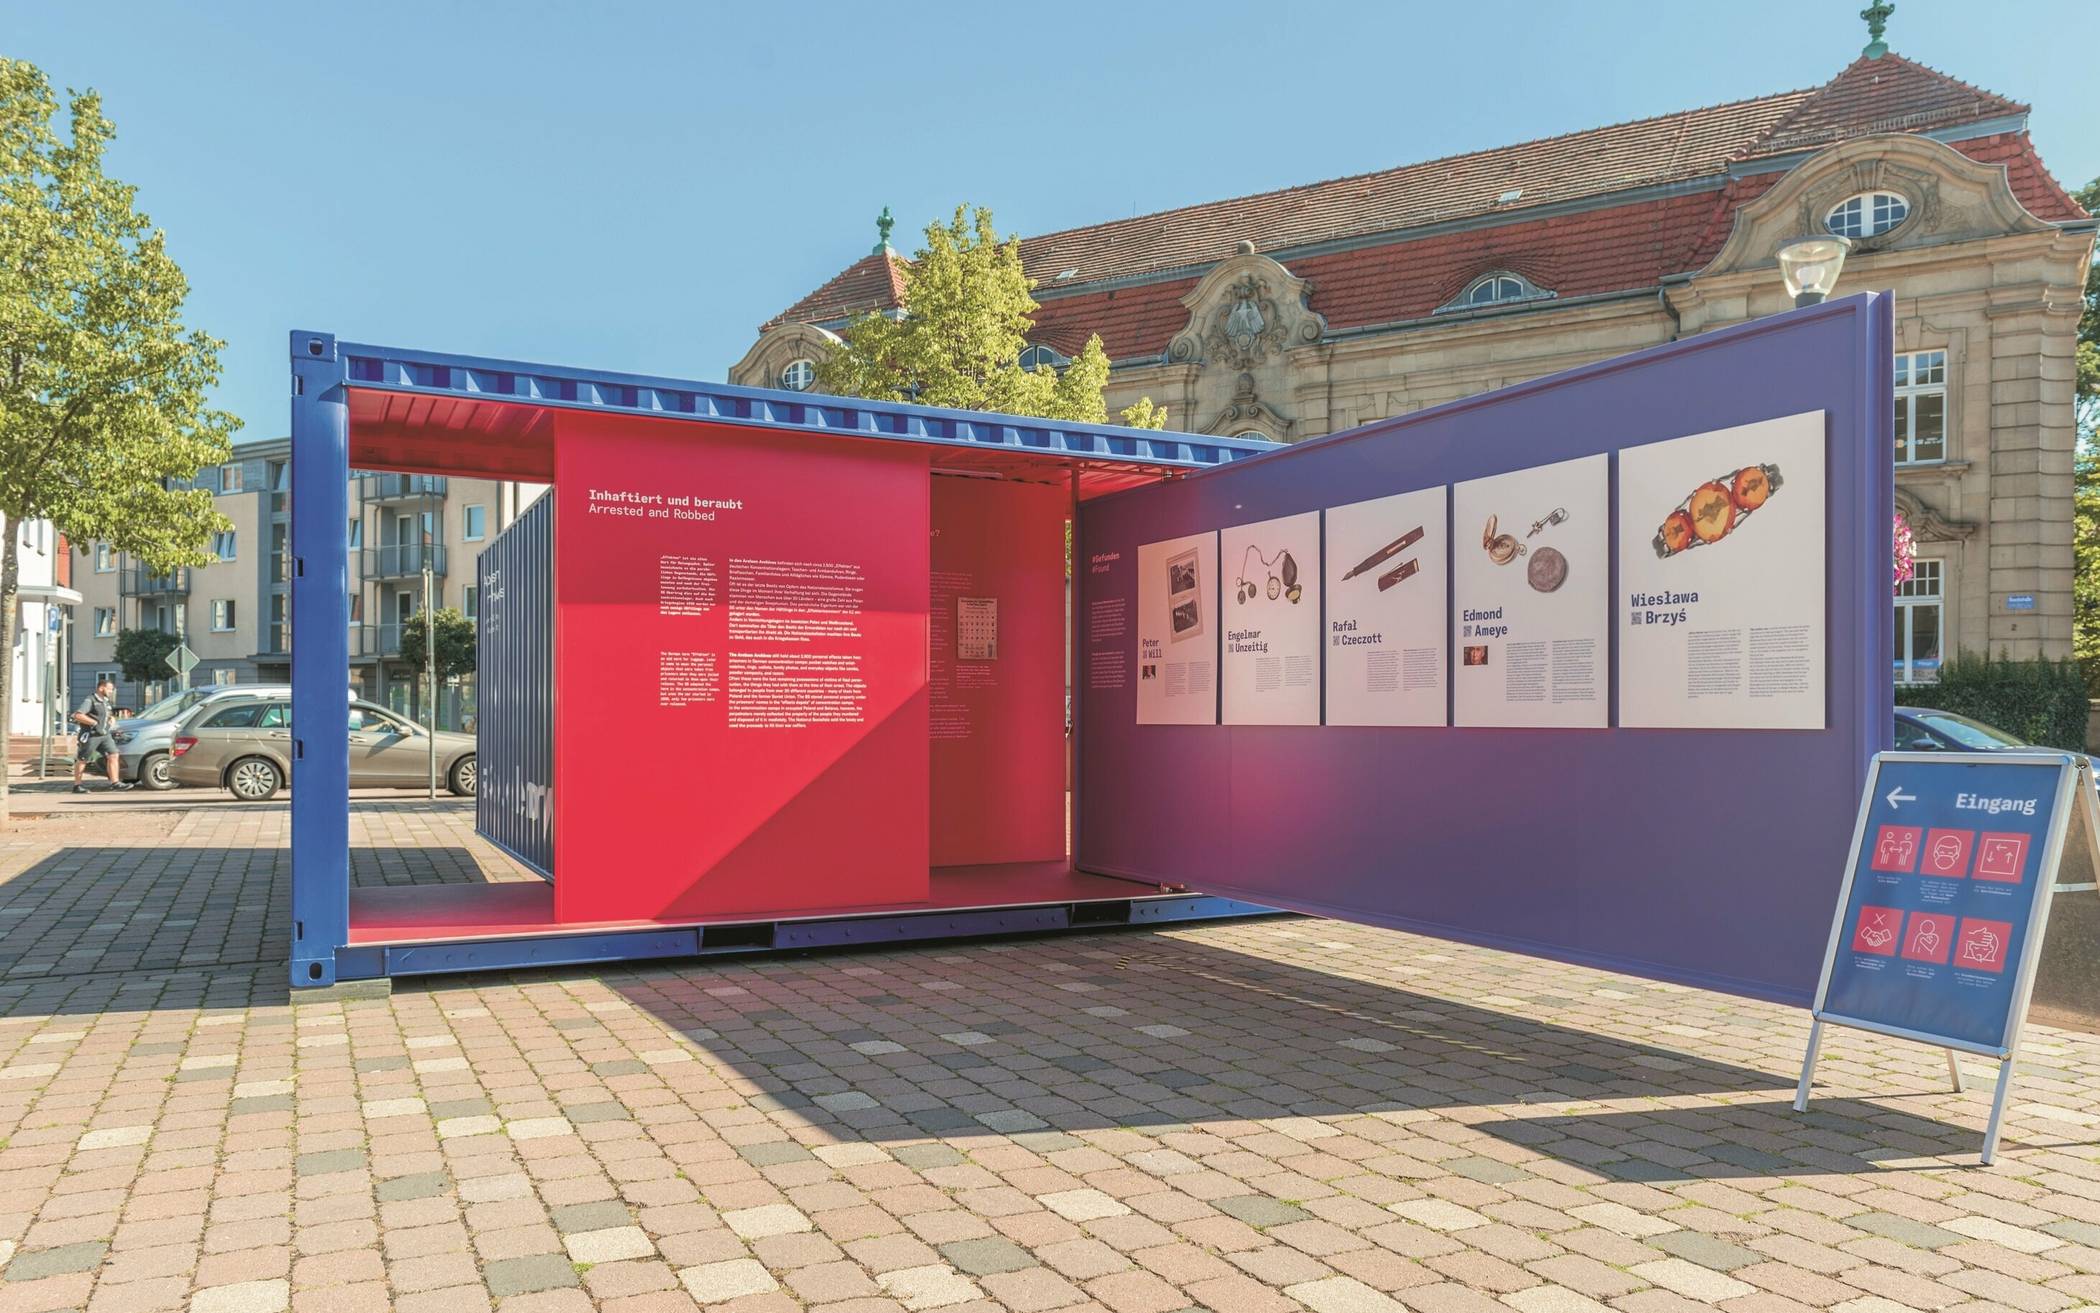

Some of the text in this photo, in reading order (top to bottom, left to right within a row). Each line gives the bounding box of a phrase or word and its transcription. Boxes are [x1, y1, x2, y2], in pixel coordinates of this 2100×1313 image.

[588, 489, 743, 510] Inhaftiert und beraubt
[589, 503, 715, 521] Arrested and Robbed
[1631, 591, 1699, 607] Wiesława
[1463, 606, 1503, 621] Edmond
[1645, 608, 1687, 626] Brzyś
[1228, 629, 1261, 643] Engelmar
[1474, 625, 1508, 639] Ameye
[1142, 638, 1159, 648] Peter
[1341, 633, 1382, 646] Czeczott
[1148, 648, 1162, 659] Will
[1235, 641, 1268, 654] Unzeitig
[1956, 792, 2037, 816] Eingang
